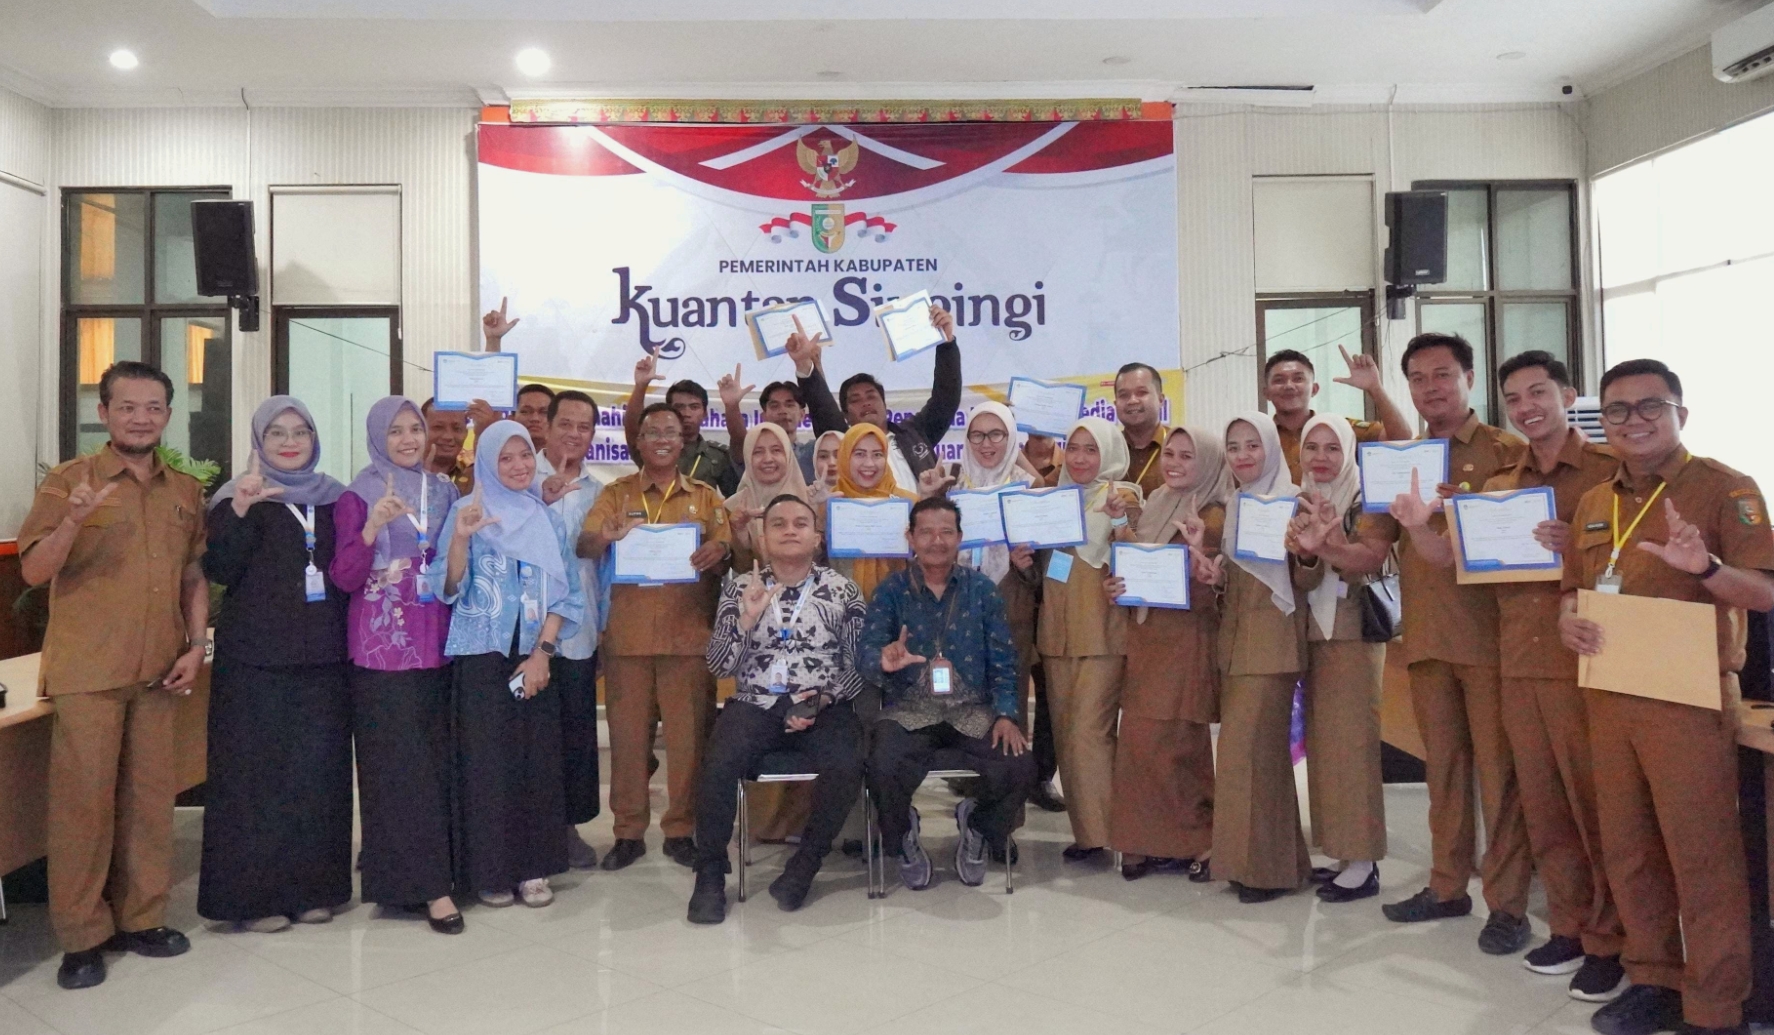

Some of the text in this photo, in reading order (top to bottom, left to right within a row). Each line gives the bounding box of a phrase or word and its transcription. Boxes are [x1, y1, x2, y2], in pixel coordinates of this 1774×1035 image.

[719, 258, 938, 273] PEMERINTAH KABUPATEN
[611, 266, 816, 360] Kuant
[833, 276, 1046, 341] Siingi
